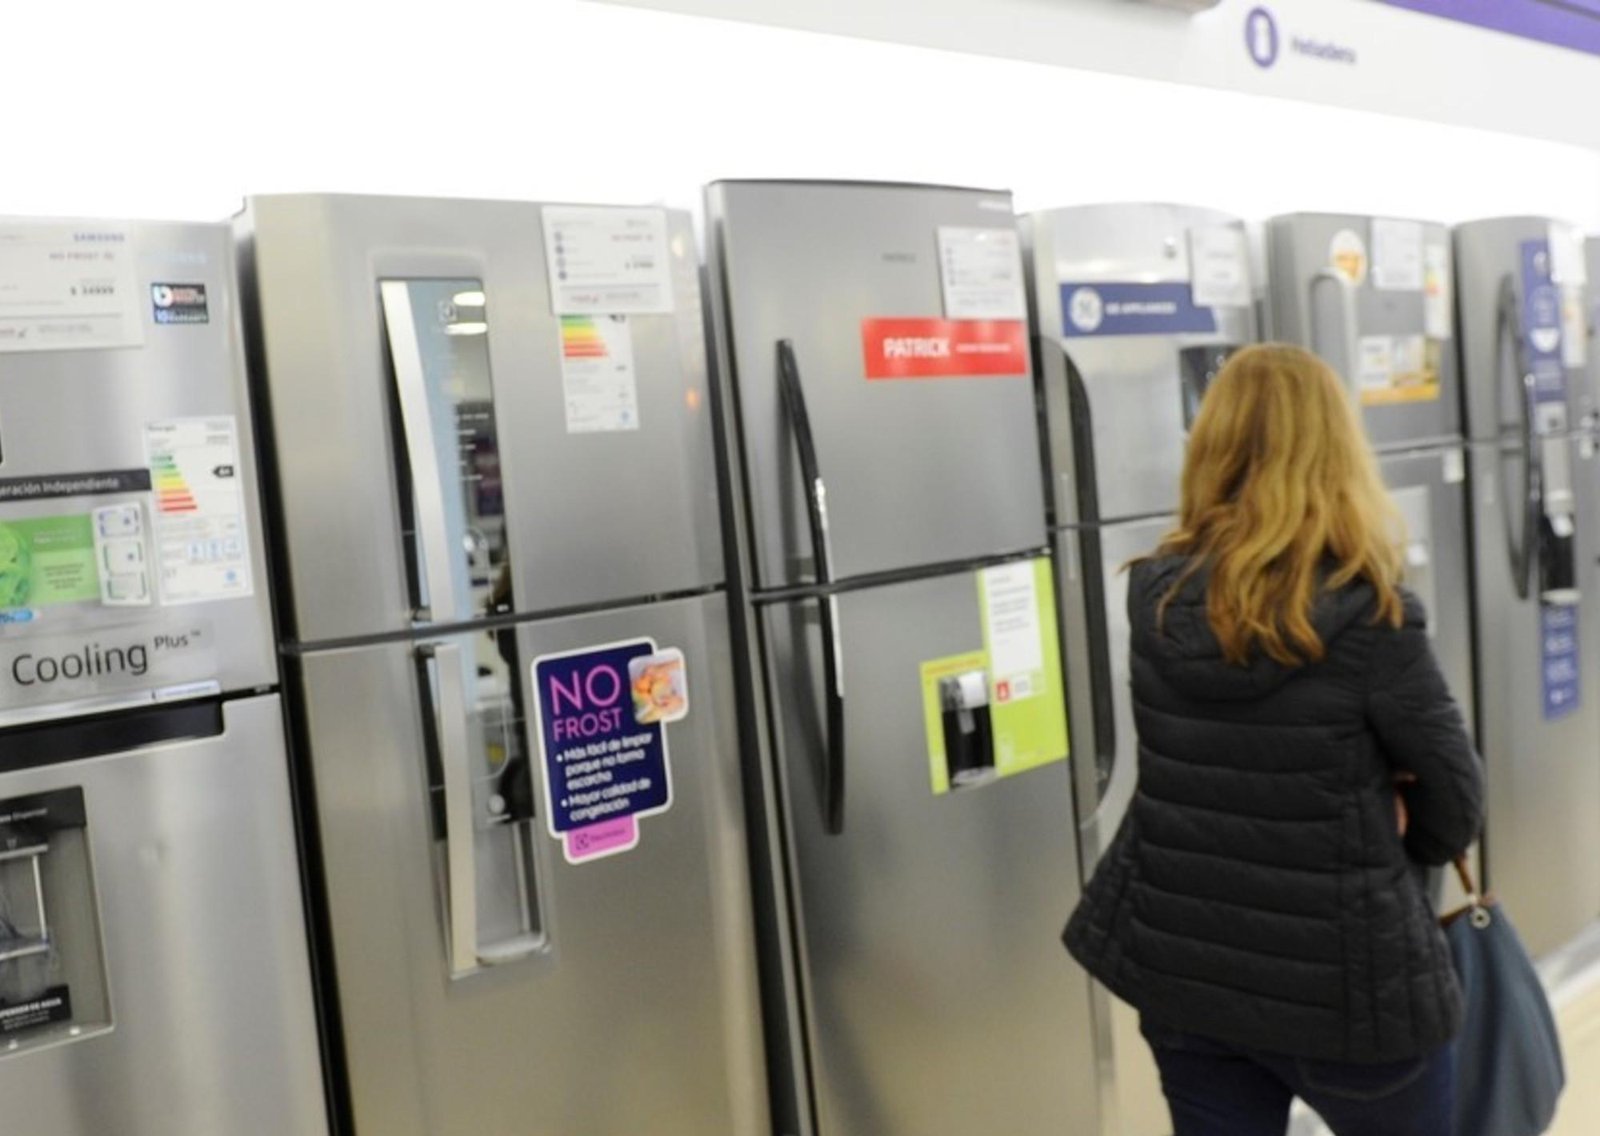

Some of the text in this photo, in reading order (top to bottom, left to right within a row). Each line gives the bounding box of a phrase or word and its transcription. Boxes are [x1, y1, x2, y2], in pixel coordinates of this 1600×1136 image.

[882, 337, 951, 359] PATRICK
[43, 477, 120, 494] Independiente
[11, 643, 149, 686] Cooling
[549, 664, 622, 716] NO
[552, 707, 623, 742] FROST
[563, 746, 587, 762] Más
[607, 738, 622, 752] de
[565, 747, 646, 778] porque no forma
[566, 769, 614, 791] escarcha
[568, 776, 652, 808] Mayor calidad de
[569, 796, 631, 822] congelación
